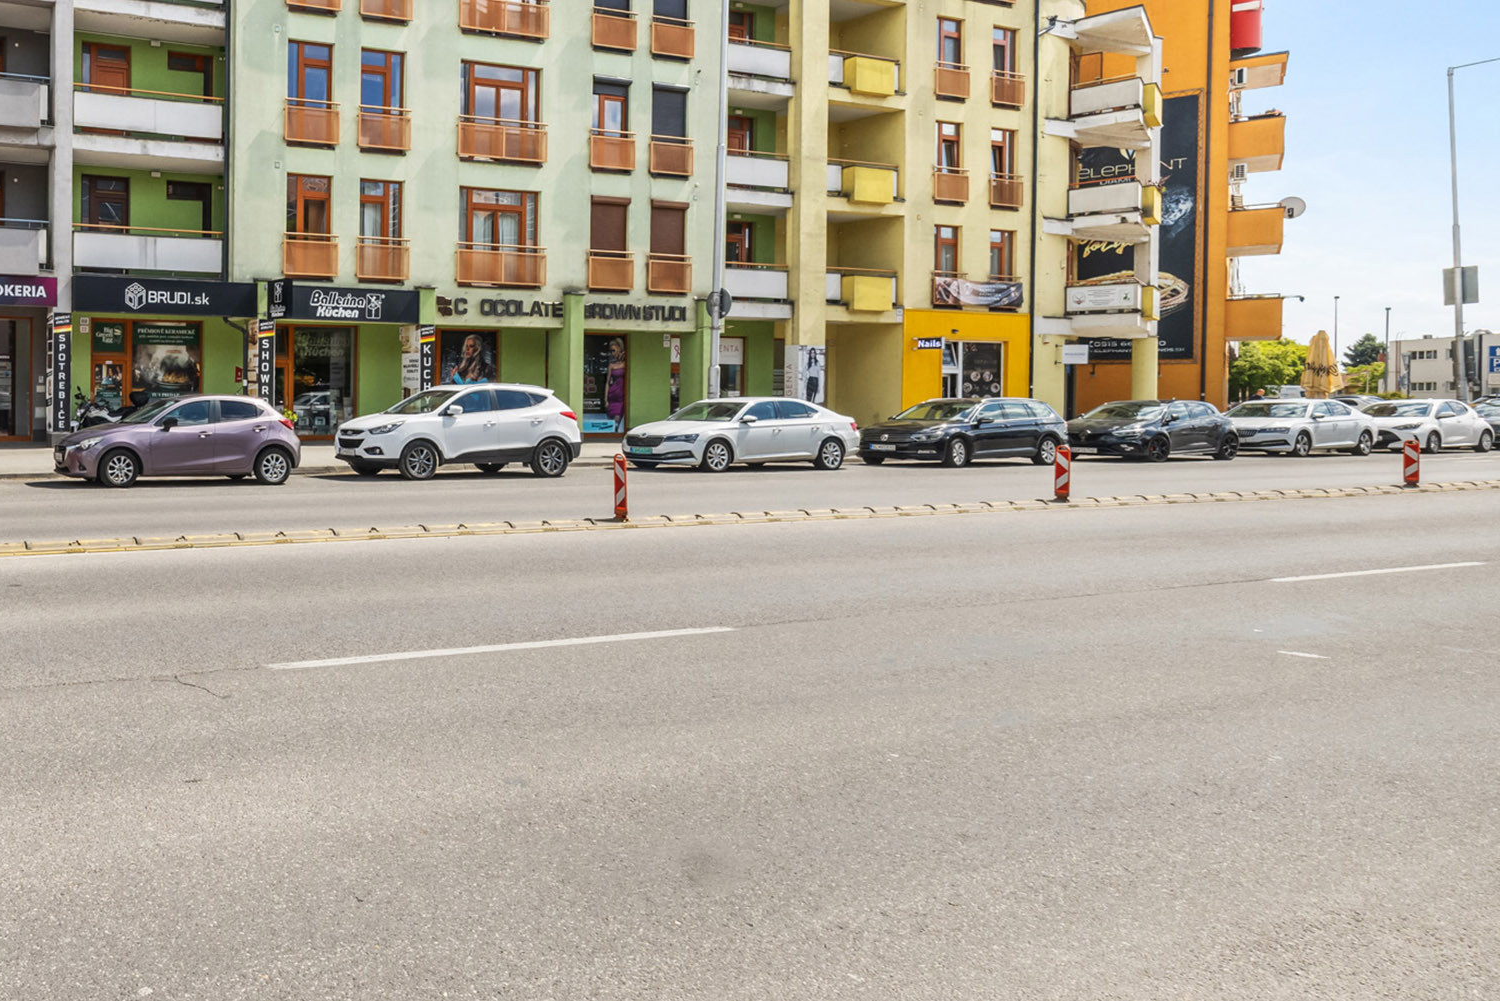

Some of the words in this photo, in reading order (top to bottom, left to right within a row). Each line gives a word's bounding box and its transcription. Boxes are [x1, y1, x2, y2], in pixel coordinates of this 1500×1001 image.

[148, 290, 210, 306] BRUDI.sk
[310, 289, 366, 309] Ballerina
[316, 306, 360, 318] Küchen
[584, 303, 640, 320] BROWN
[719, 344, 740, 352] ENTA
[58, 334, 66, 428] SPOTREBIČE
